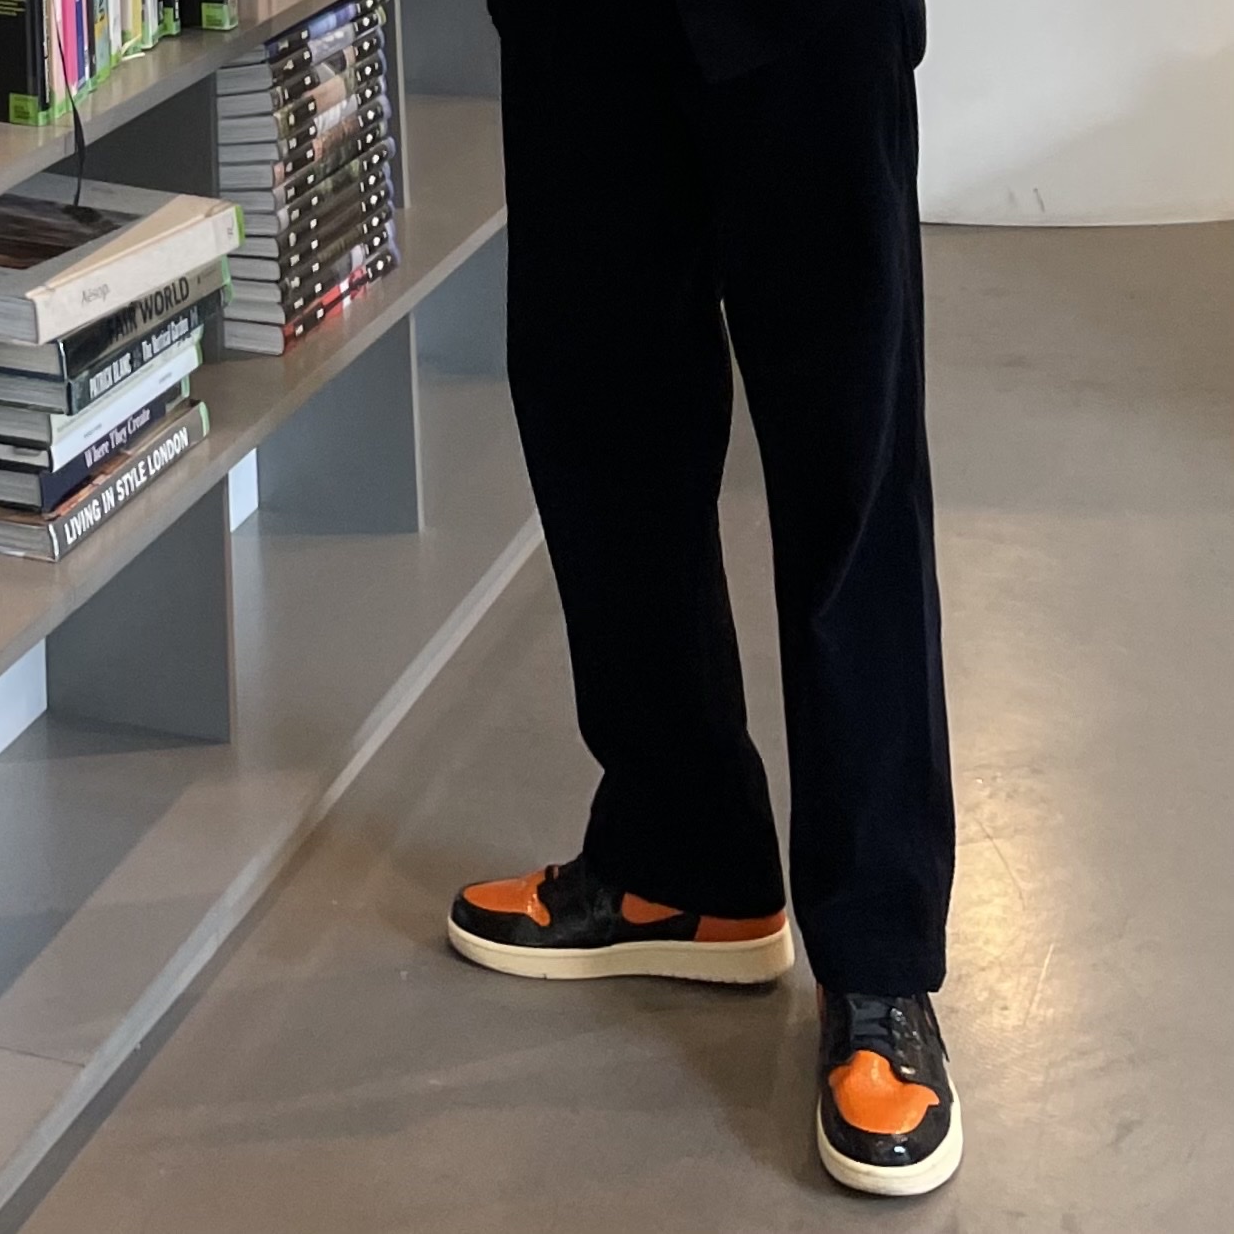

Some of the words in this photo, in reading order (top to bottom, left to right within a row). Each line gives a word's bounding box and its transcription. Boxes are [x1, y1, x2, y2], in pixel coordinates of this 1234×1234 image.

[140, 275, 190, 326] WORLD
[84, 435, 110, 469] Where
[110, 425, 128, 456] They
[127, 408, 151, 440] Create
[63, 498, 103, 545] LIVING
[101, 488, 116, 516] IN
[116, 459, 148, 502] STYLE
[148, 426, 190, 483] LONDON
